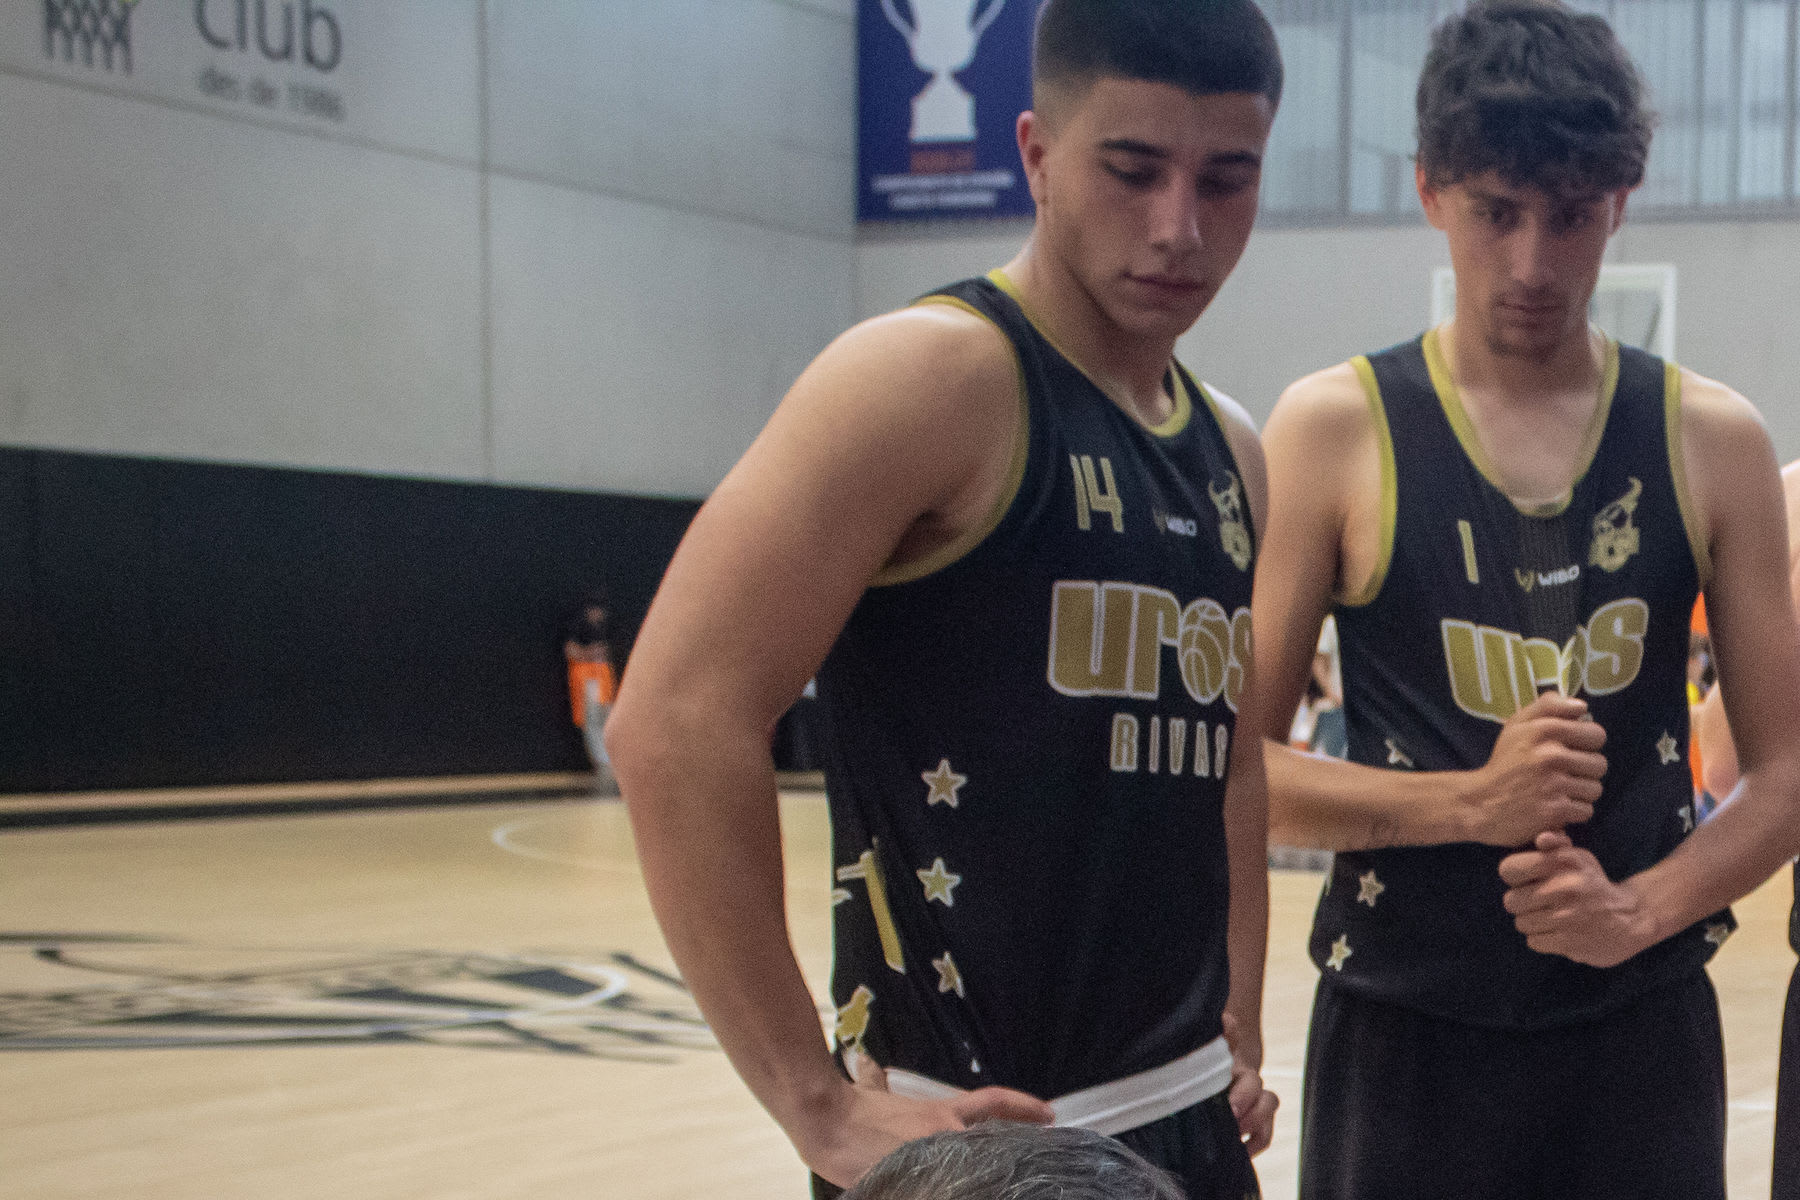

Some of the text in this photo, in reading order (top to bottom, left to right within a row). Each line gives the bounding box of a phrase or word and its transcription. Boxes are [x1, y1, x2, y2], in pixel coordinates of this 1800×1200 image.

[1069, 453, 1125, 534] 14
[1457, 518, 1480, 585] 1
[1110, 712, 1229, 780] RIVAS
